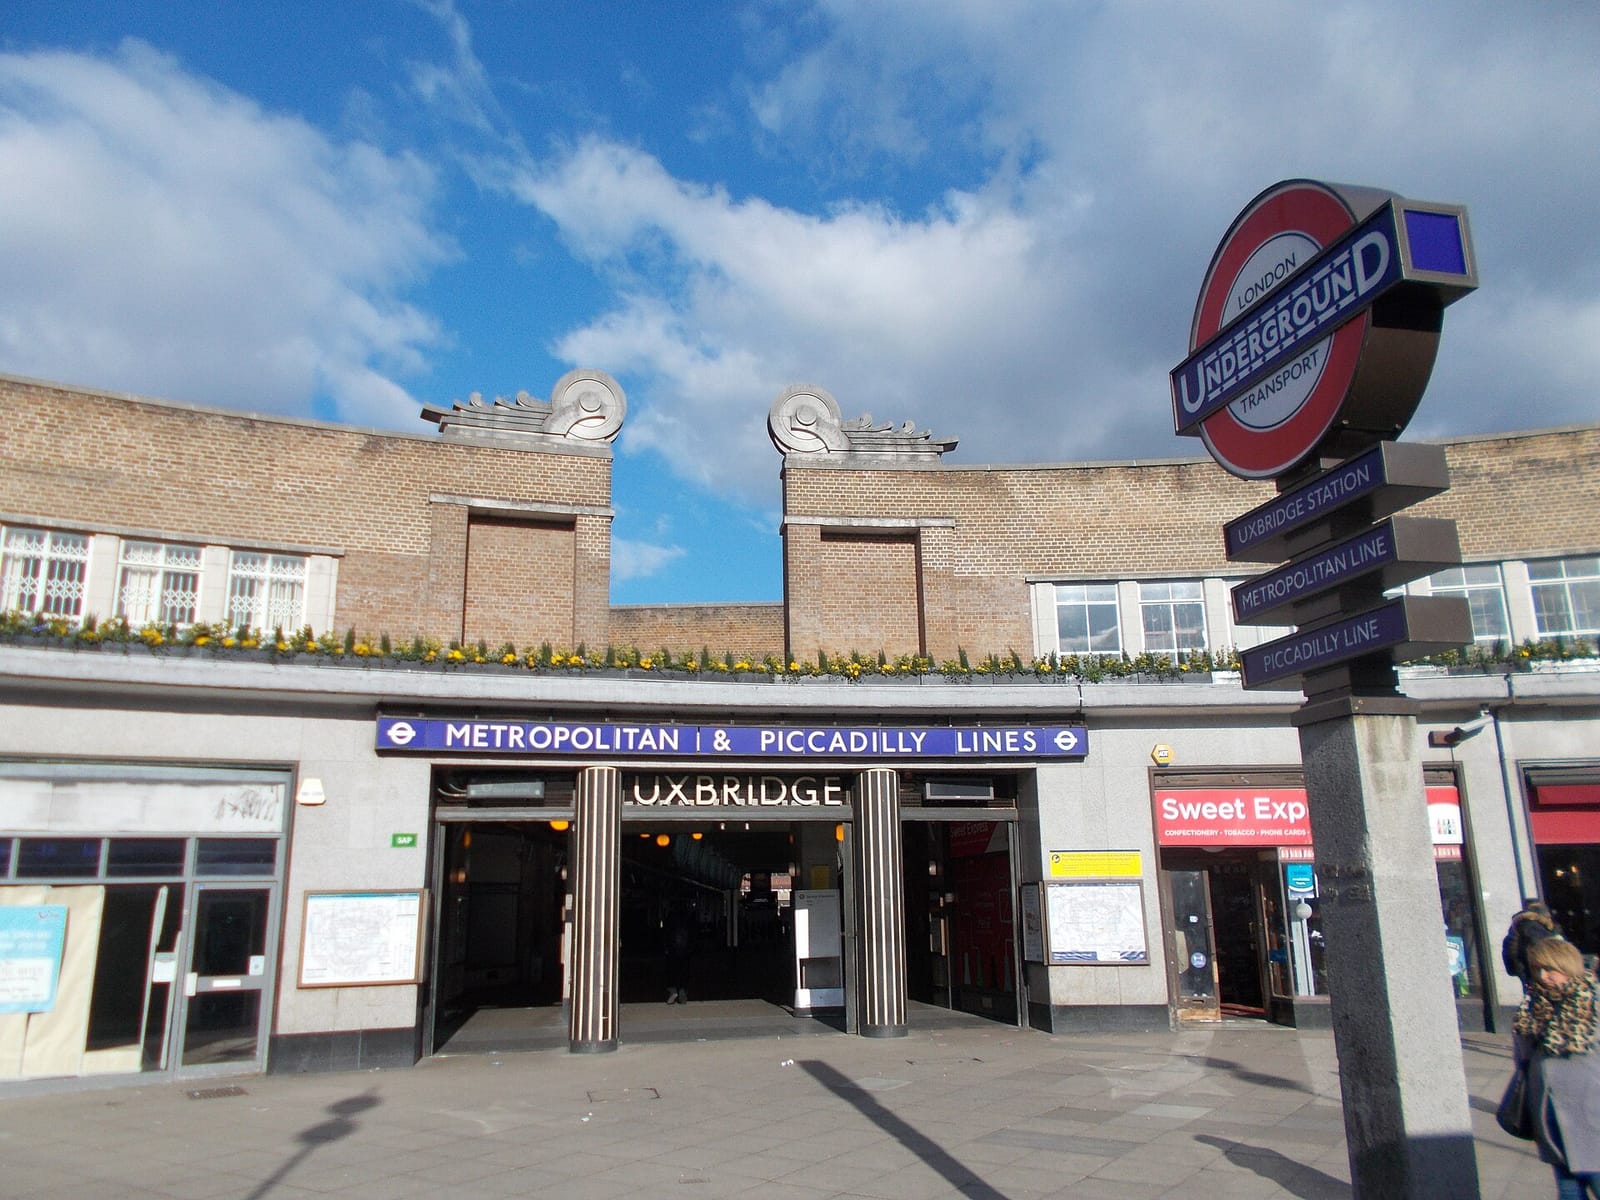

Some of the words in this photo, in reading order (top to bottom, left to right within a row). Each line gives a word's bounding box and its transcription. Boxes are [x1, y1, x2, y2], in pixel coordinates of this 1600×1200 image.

[1237, 252, 1296, 310] LONDON
[1180, 231, 1390, 414] UNDERGROUND
[1240, 350, 1320, 414] TRANSPORT
[1238, 501, 1305, 544] UXBRIDGE
[1307, 464, 1370, 511] STATION
[1242, 552, 1347, 611] METROPOLITAN
[1350, 536, 1387, 567] LINE
[1263, 631, 1341, 673] PICCADILLY
[1344, 618, 1380, 646] LINE
[445, 723, 679, 751] METROPOLITAN
[713, 729, 732, 751] &
[760, 730, 927, 753] PICCADILLY
[957, 729, 1037, 752] LINES
[633, 775, 842, 805] UXBRIDGE
[1162, 797, 1246, 820] Sweet
[1253, 797, 1309, 824] Exp
